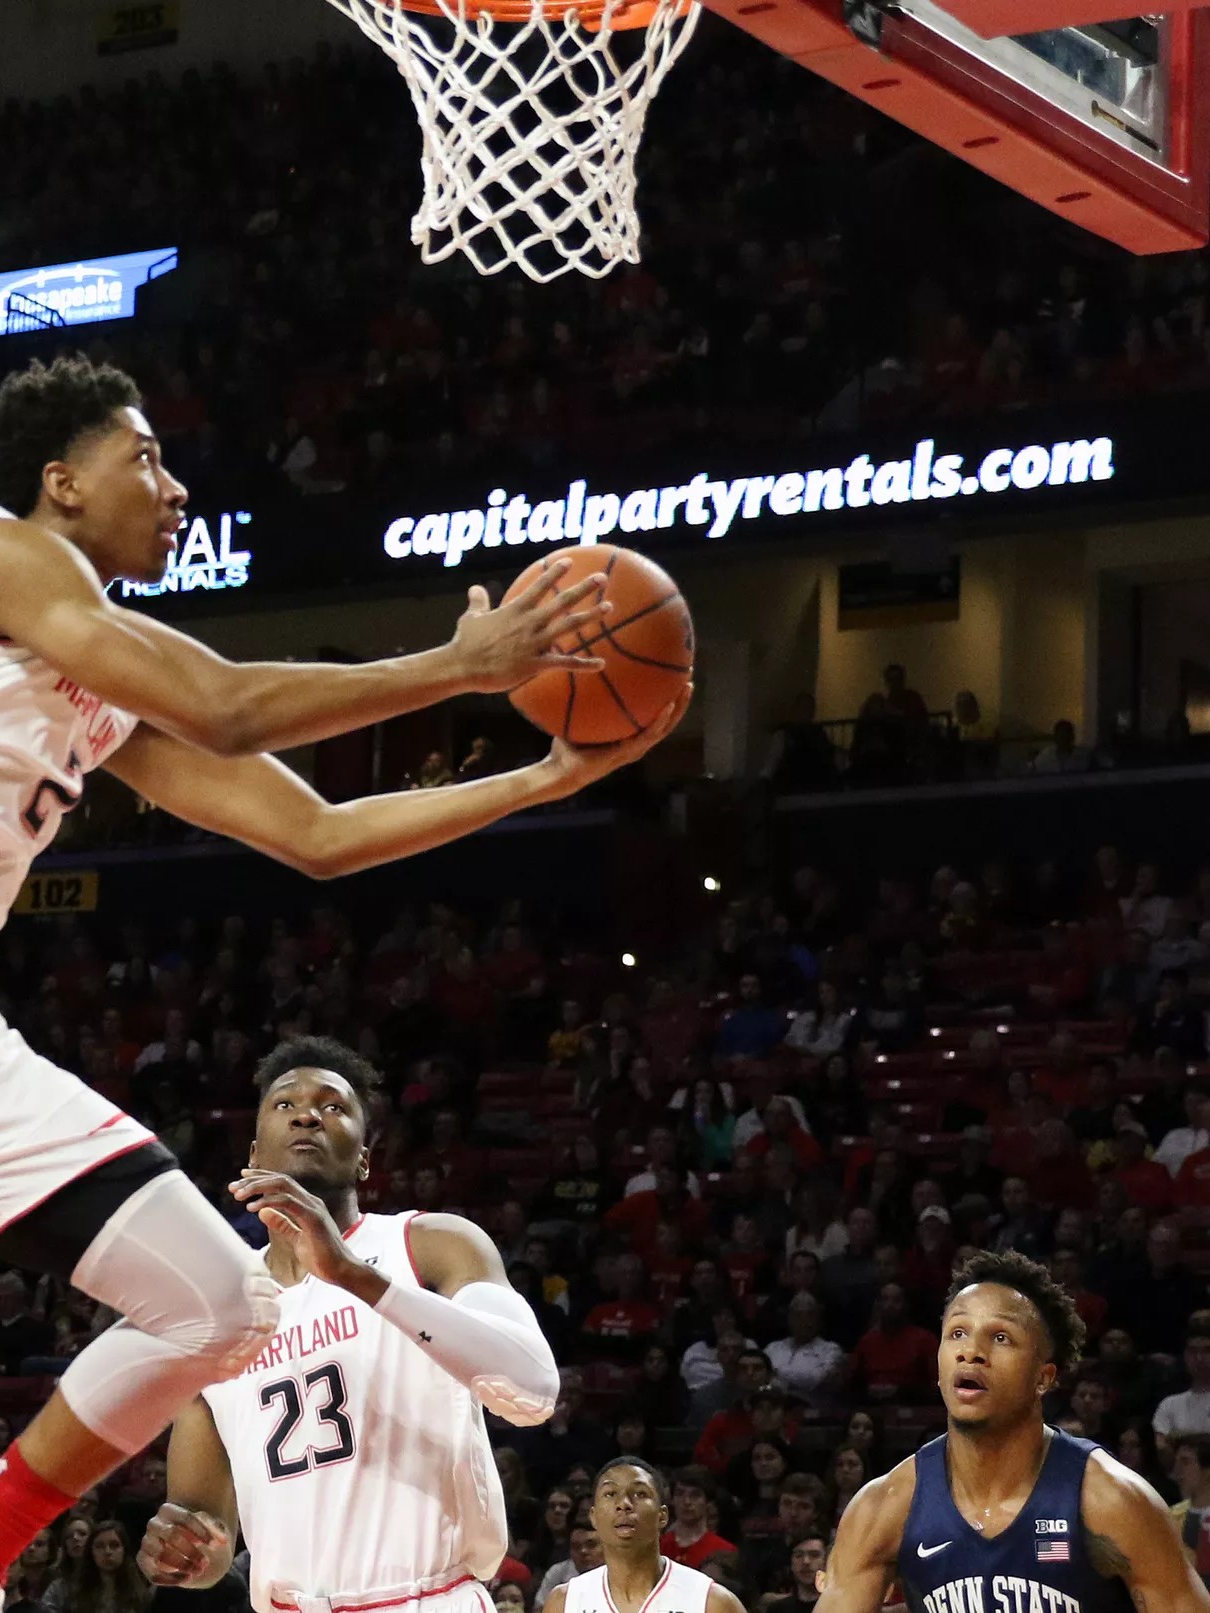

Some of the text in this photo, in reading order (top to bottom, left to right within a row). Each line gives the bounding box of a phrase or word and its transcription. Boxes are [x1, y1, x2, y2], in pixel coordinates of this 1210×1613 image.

[384, 436, 1114, 566] capitalpartyrentals.com
[30, 878, 82, 909] 102
[239, 1305, 359, 1375] ARYLAND
[258, 1359, 357, 1484] 23
